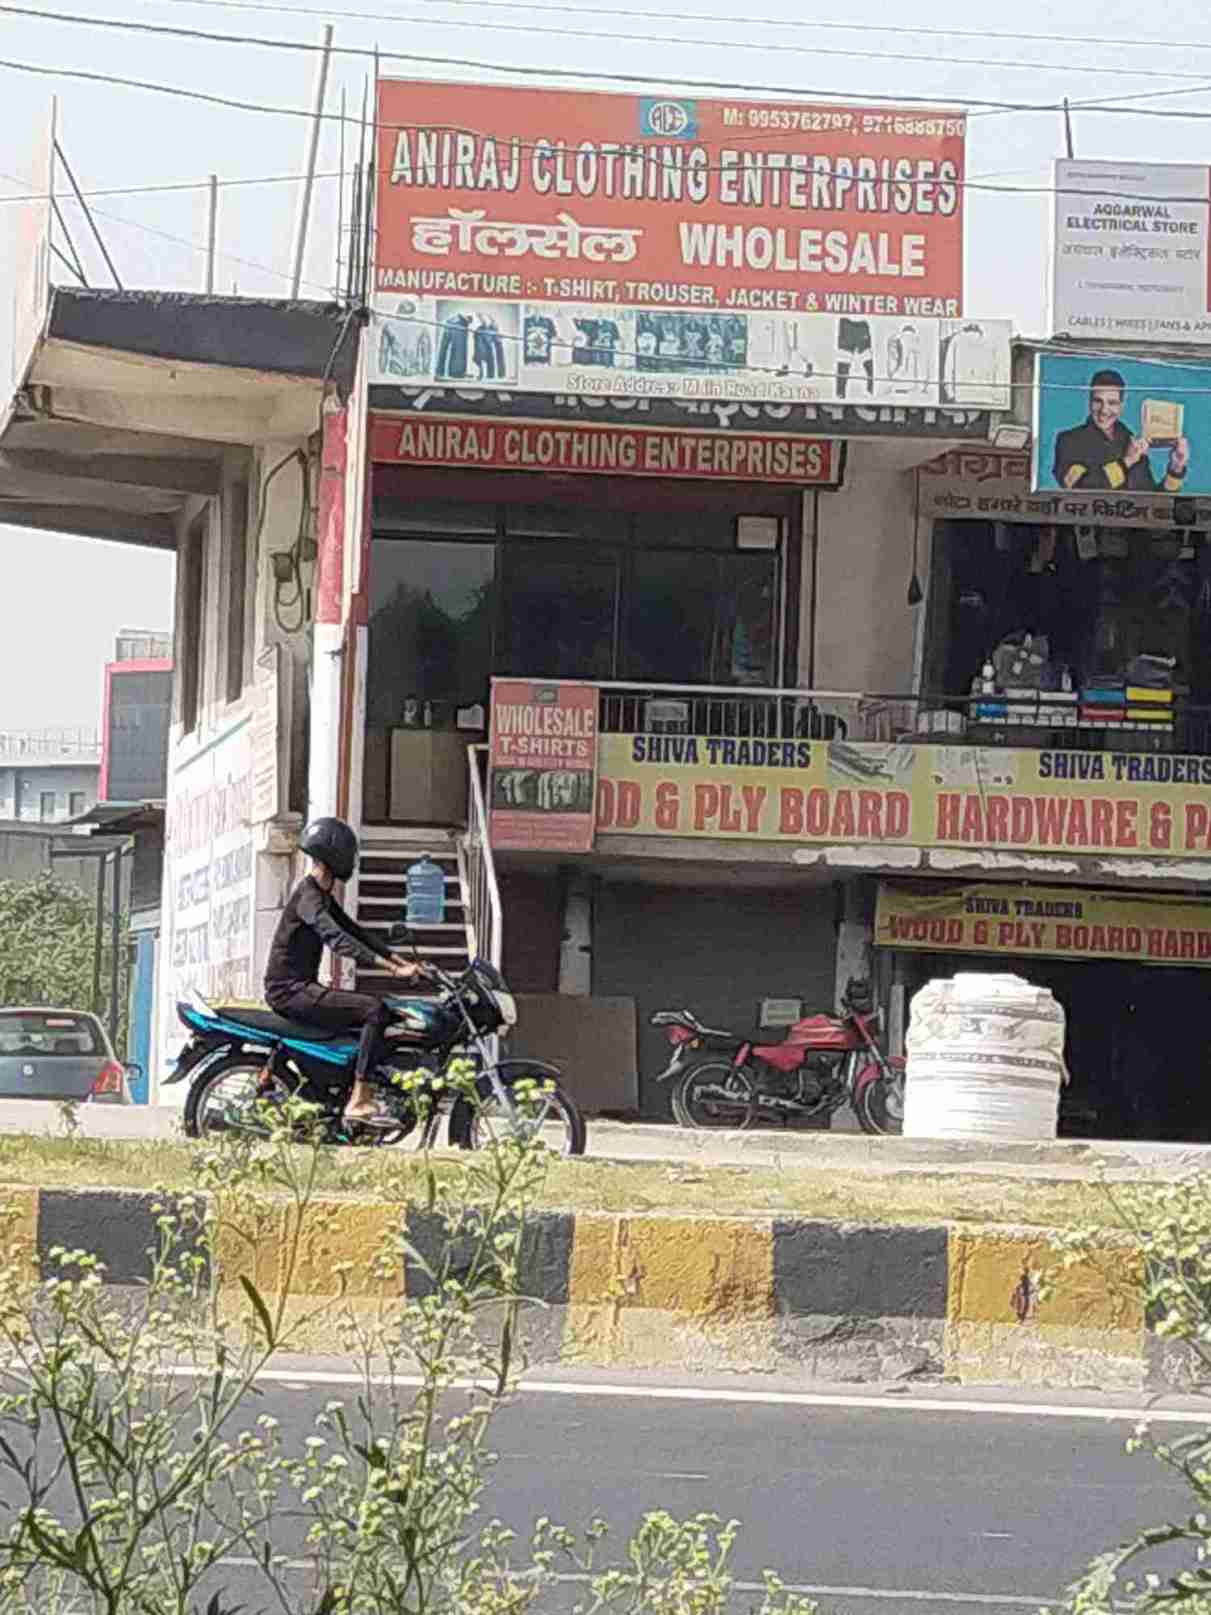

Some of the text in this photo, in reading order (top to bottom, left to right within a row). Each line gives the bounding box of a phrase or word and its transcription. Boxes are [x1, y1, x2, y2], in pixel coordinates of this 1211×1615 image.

[390, 128, 959, 216] ANIRAJ CLOTHING ENTERPRISES
[409, 207, 643, 263] हॉलसेल
[1151, 220, 1200, 234] STORE
[679, 222, 926, 278] WHOLESALE
[377, 267, 521, 295] MANUFACTURE
[725, 288, 799, 309] JACKET
[806, 293, 819, 311] &
[825, 292, 897, 314] WINTER
[903, 297, 959, 318] WEAR
[399, 423, 822, 478] ANIRAJ CLOTHING ENTERPRISES
[495, 704, 594, 738] WHOLESALE
[500, 736, 589, 758] T-SHIRTS
[632, 735, 812, 769] SHIVA TRADERS
[1038, 752, 1211, 785] SHIVA TRADERS
[655, 783, 680, 830] &
[694, 784, 767, 833] PLY
[779, 788, 910, 840] BOARD
[936, 792, 1138, 849] HARDWARE
[1151, 801, 1171, 849] &
[965, 896, 1008, 915] SHIVA
[891, 916, 963, 945] WOOD
[1000, 922, 1047, 949] PLY
[1055, 925, 1141, 953] BOARD
